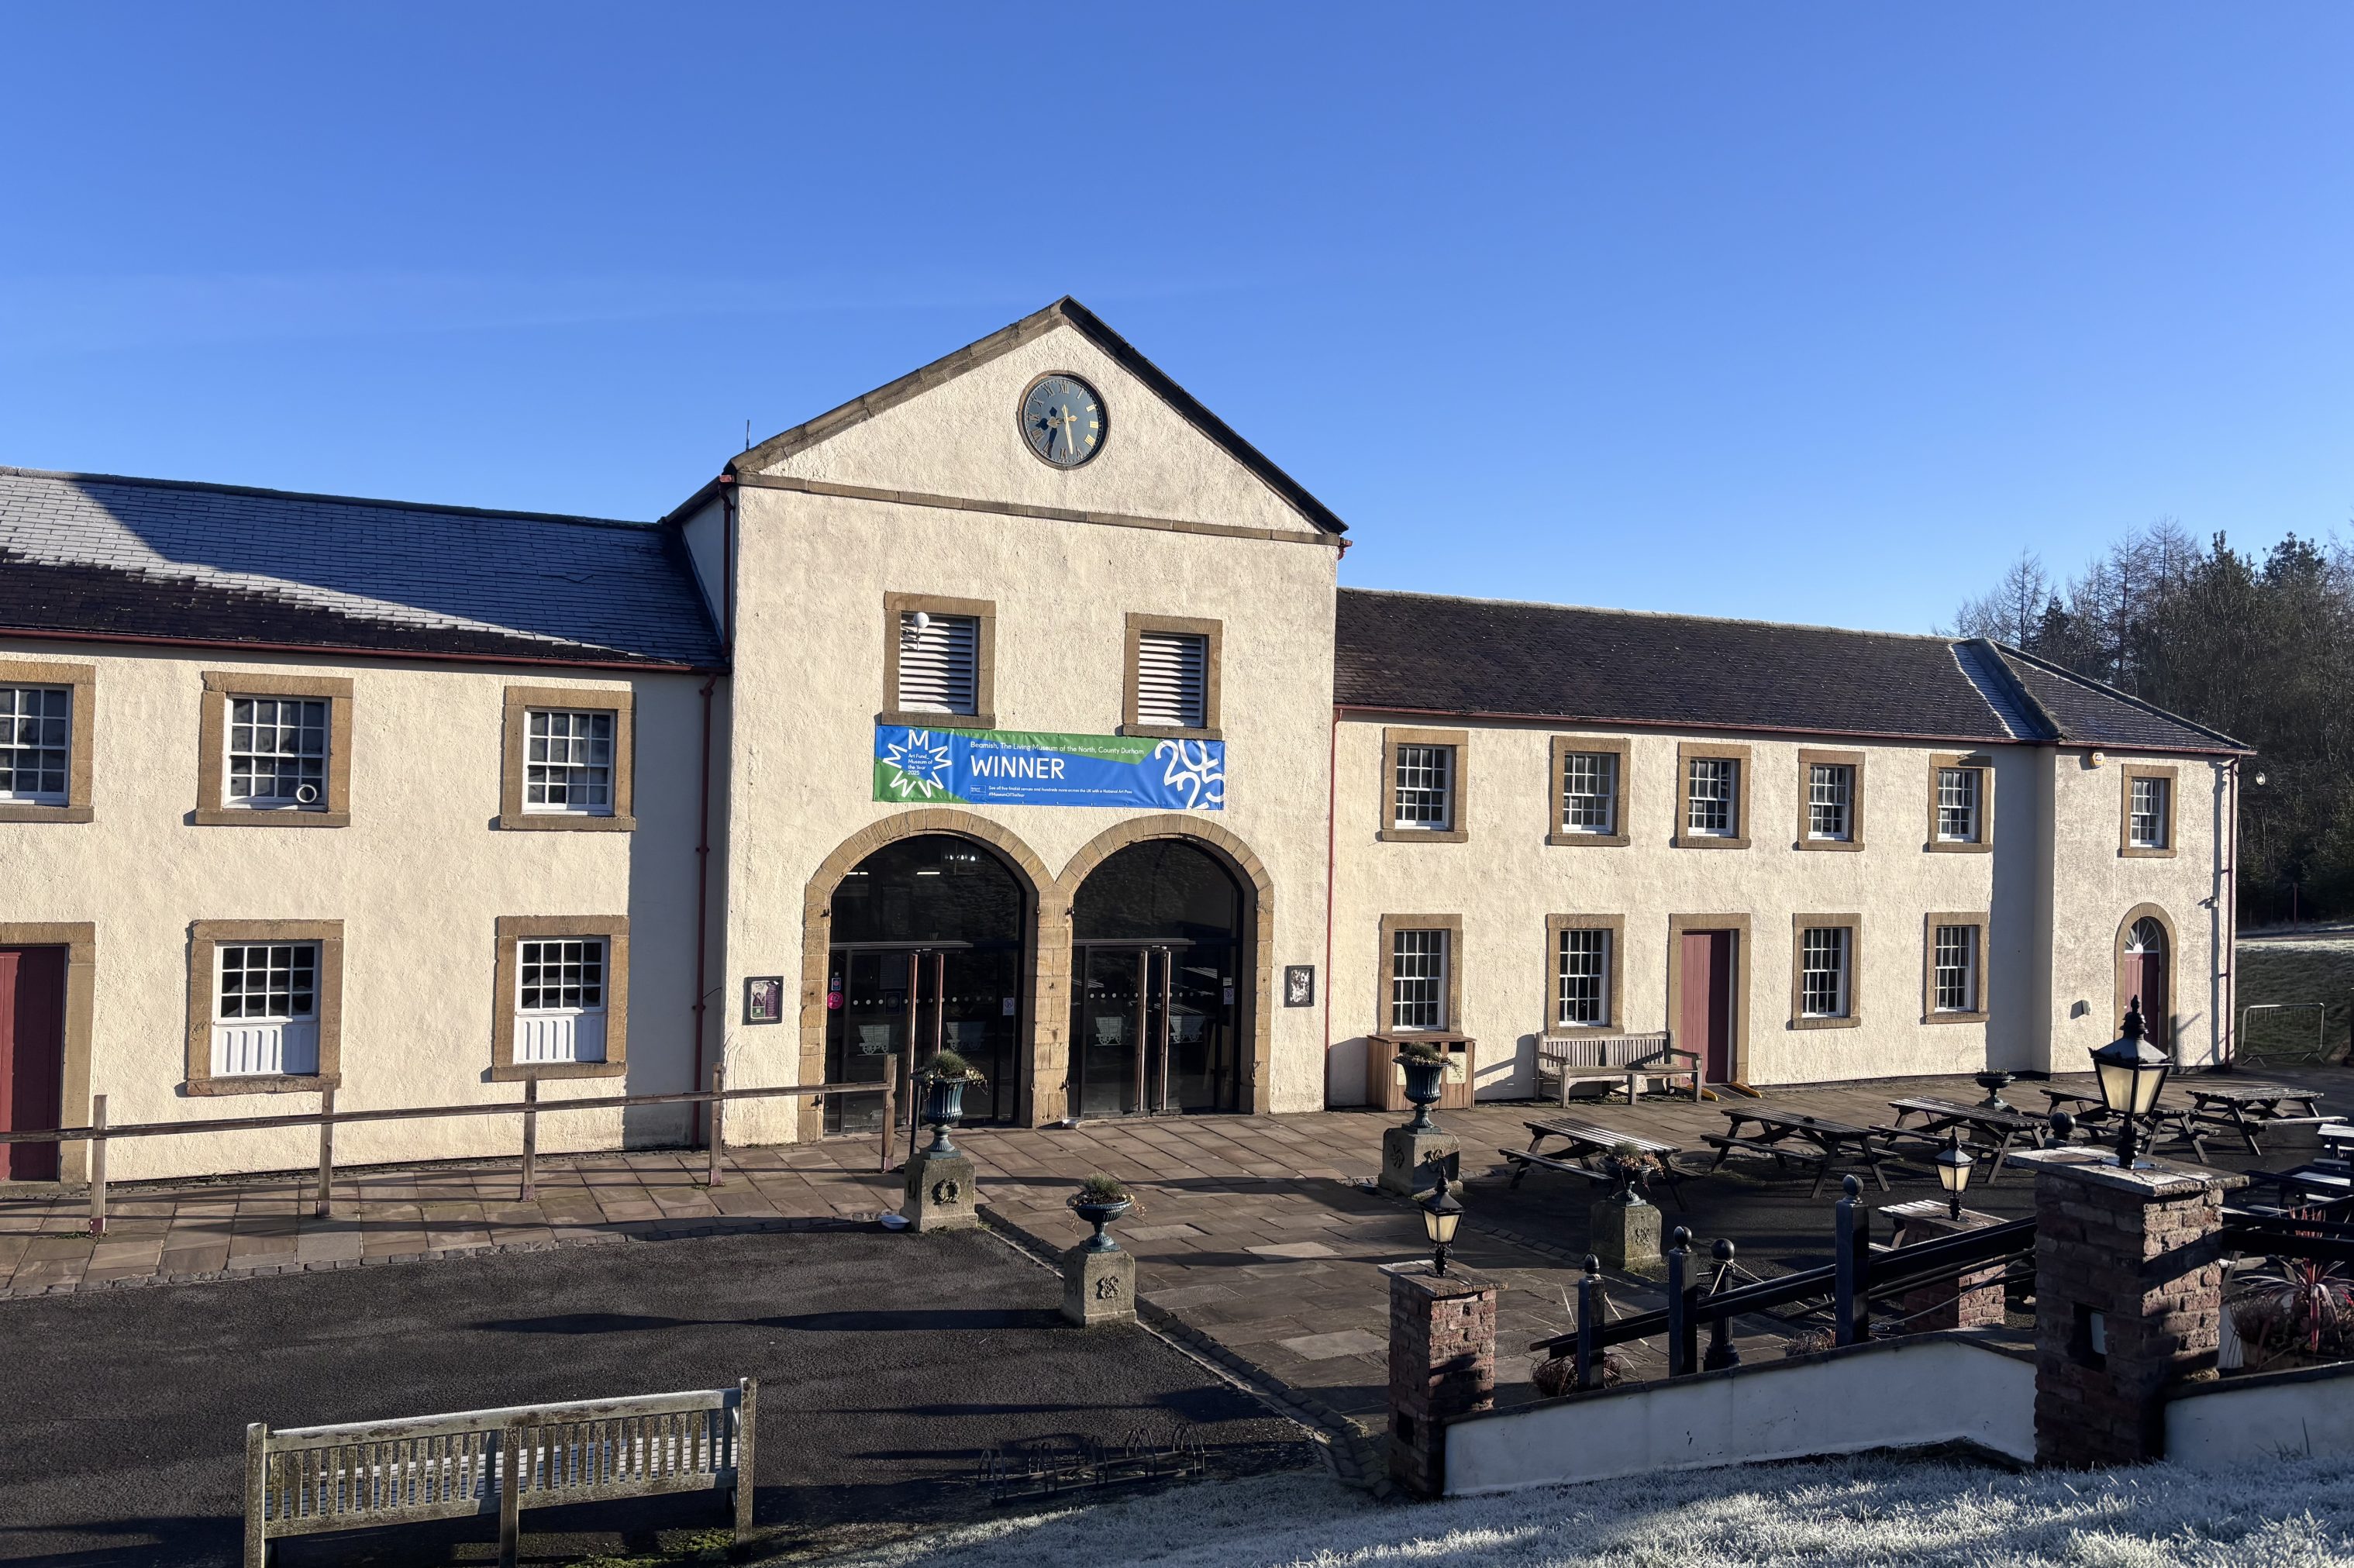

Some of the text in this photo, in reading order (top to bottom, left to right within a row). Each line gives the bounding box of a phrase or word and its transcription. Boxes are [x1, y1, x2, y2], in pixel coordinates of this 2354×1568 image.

[908, 729, 929, 750] M
[970, 741, 999, 750] Beamish,
[1013, 743, 1031, 752] Living
[1098, 746, 1120, 755] County
[970, 755, 1065, 780] WINNER
